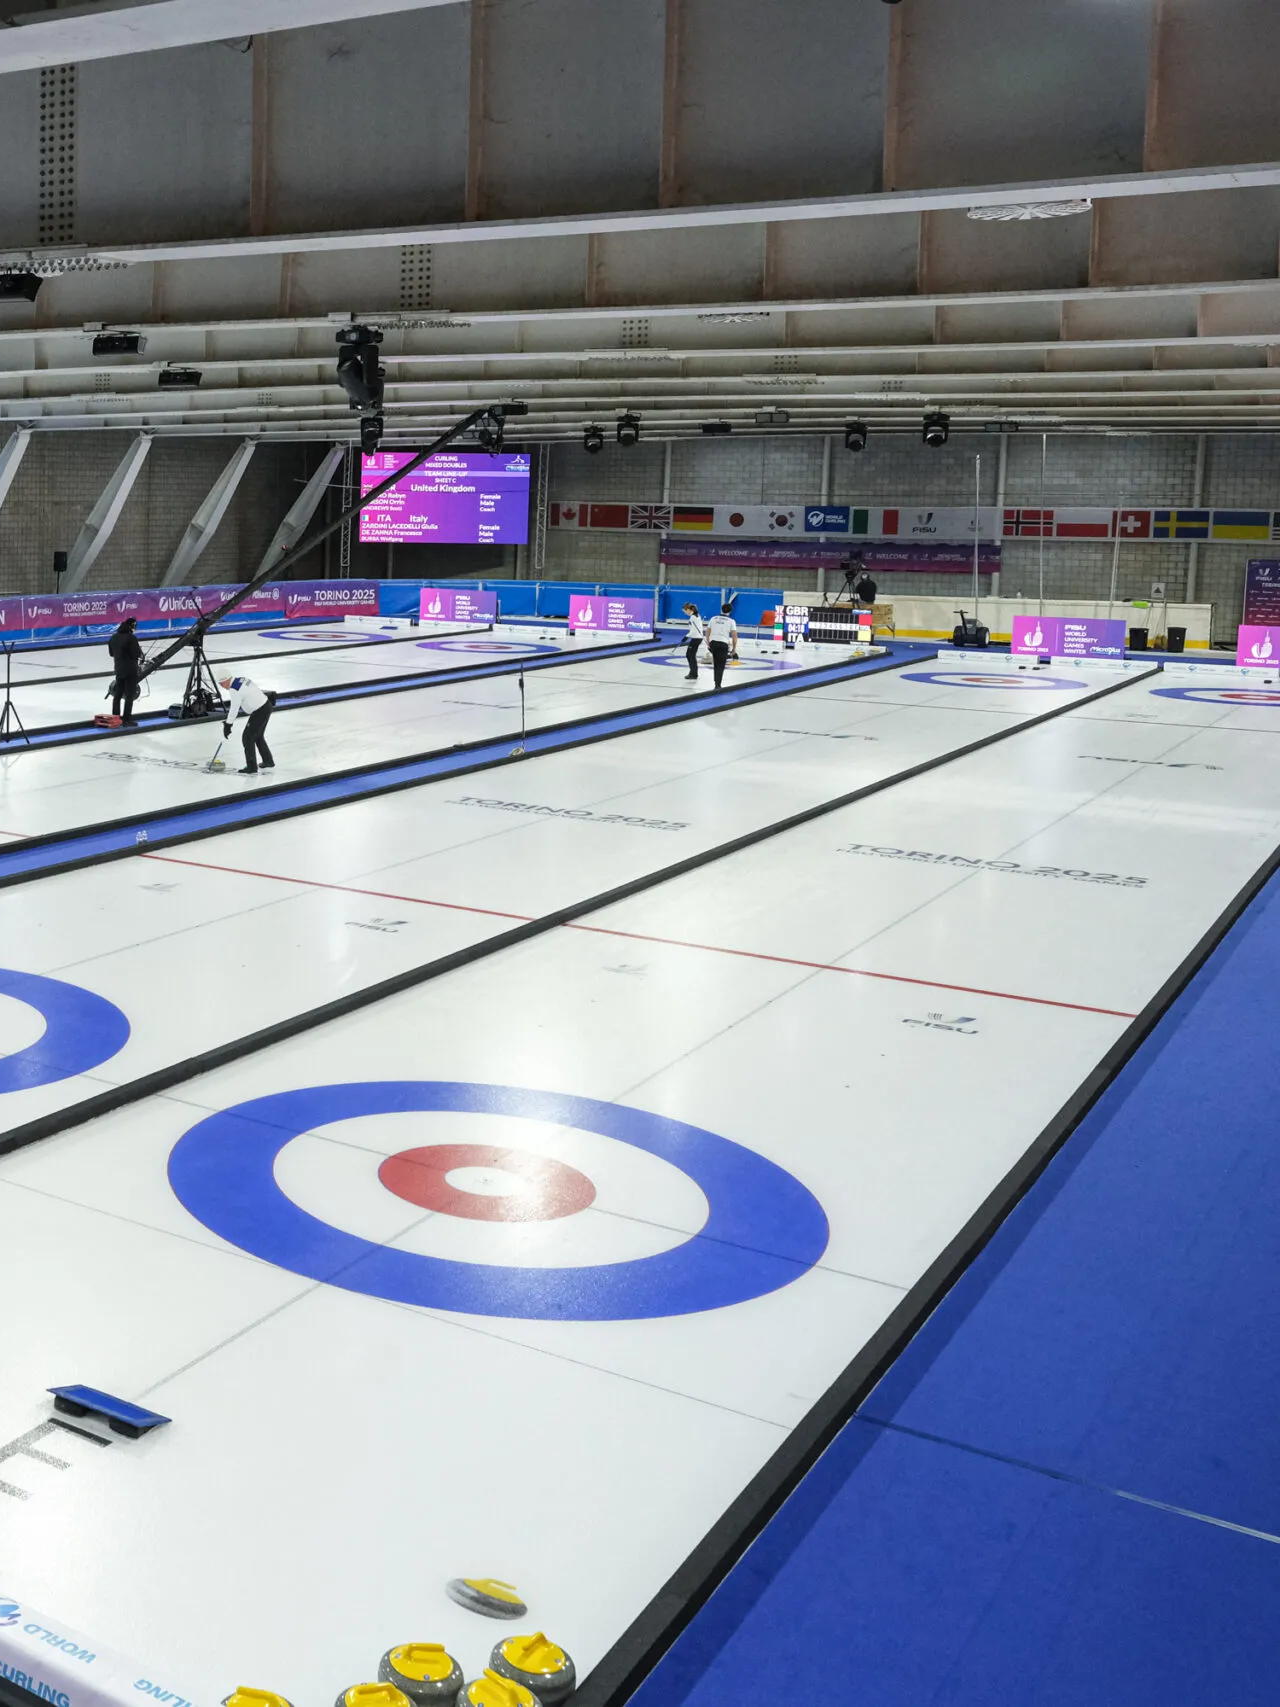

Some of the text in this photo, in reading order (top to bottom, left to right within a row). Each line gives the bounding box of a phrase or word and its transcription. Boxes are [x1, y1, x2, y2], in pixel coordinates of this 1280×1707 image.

[440, 485, 475, 493] Kingdom
[410, 515, 428, 523] Italy
[314, 589, 375, 600] TORINO 2025
[63, 602, 107, 612] TORINO 2025
[169, 596, 202, 611] UniCredit
[786, 606, 808, 616] GBR
[788, 633, 804, 642] ITA
[460, 797, 691, 828] TORINO 2025
[848, 843, 1149, 885] TORINO 2025
[880, 854, 946, 864] WORLD
[952, 862, 1061, 878] UNIVERSITY
[1072, 877, 1144, 888] GAMES
[902, 1019, 978, 1034] FISU
[23, 1624, 96, 1663] WORLD
